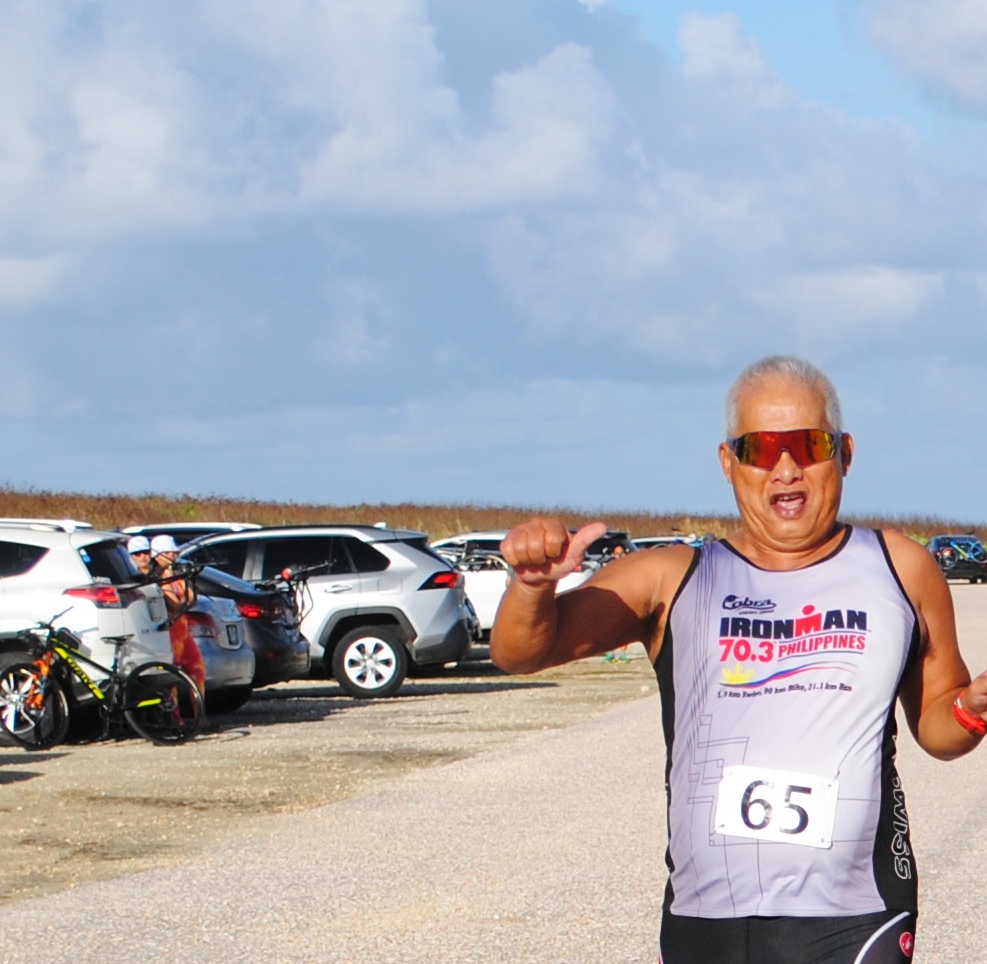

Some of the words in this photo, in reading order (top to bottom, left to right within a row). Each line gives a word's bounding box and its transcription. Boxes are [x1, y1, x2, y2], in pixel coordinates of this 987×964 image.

[719, 604, 868, 640] IRONMAN
[719, 639, 774, 663] 70.3
[777, 634, 866, 659] PHILIPPINES
[740, 779, 813, 835] 65
